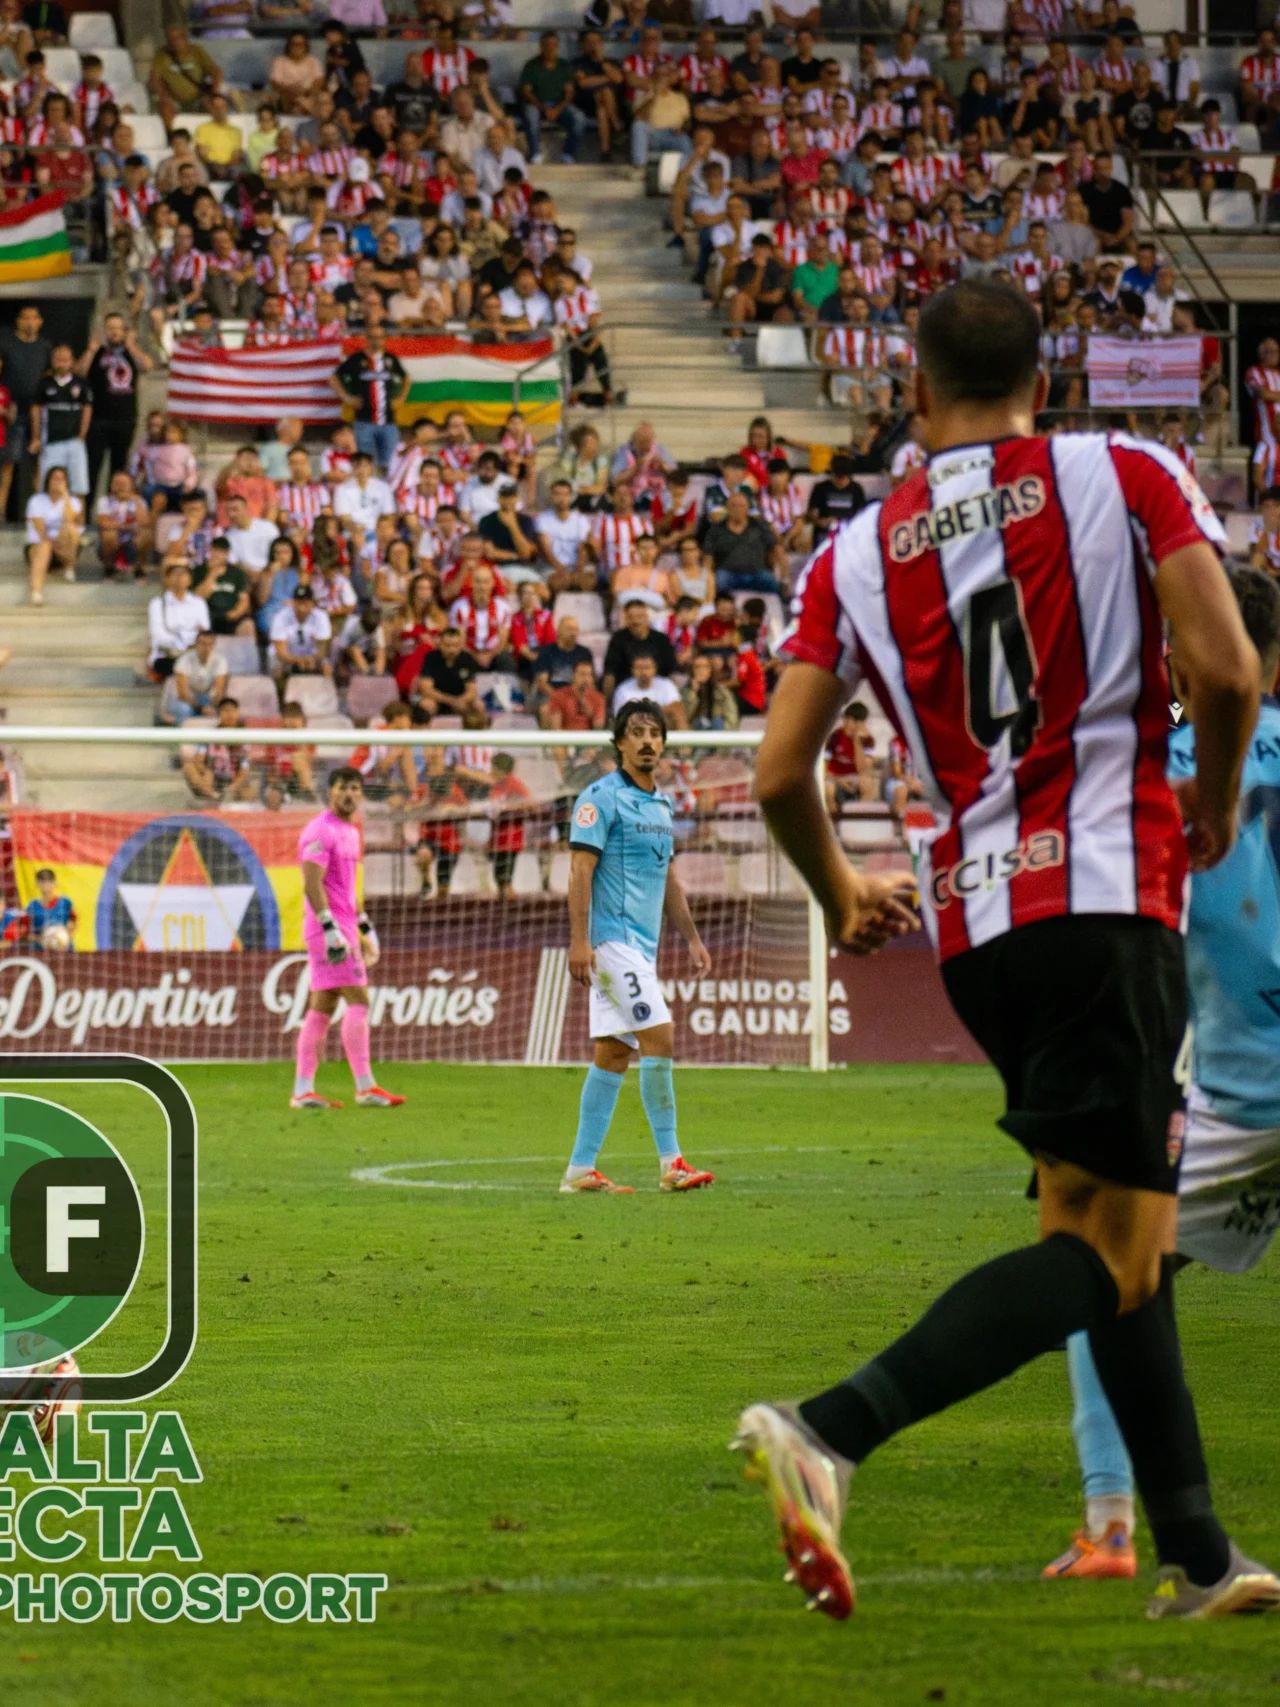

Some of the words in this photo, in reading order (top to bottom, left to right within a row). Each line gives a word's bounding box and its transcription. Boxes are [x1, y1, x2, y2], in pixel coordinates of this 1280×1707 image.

[890, 475, 1045, 562] GABETAS
[966, 578, 1040, 760] 4
[624, 972, 642, 997] 3
[828, 979, 848, 1002] A
